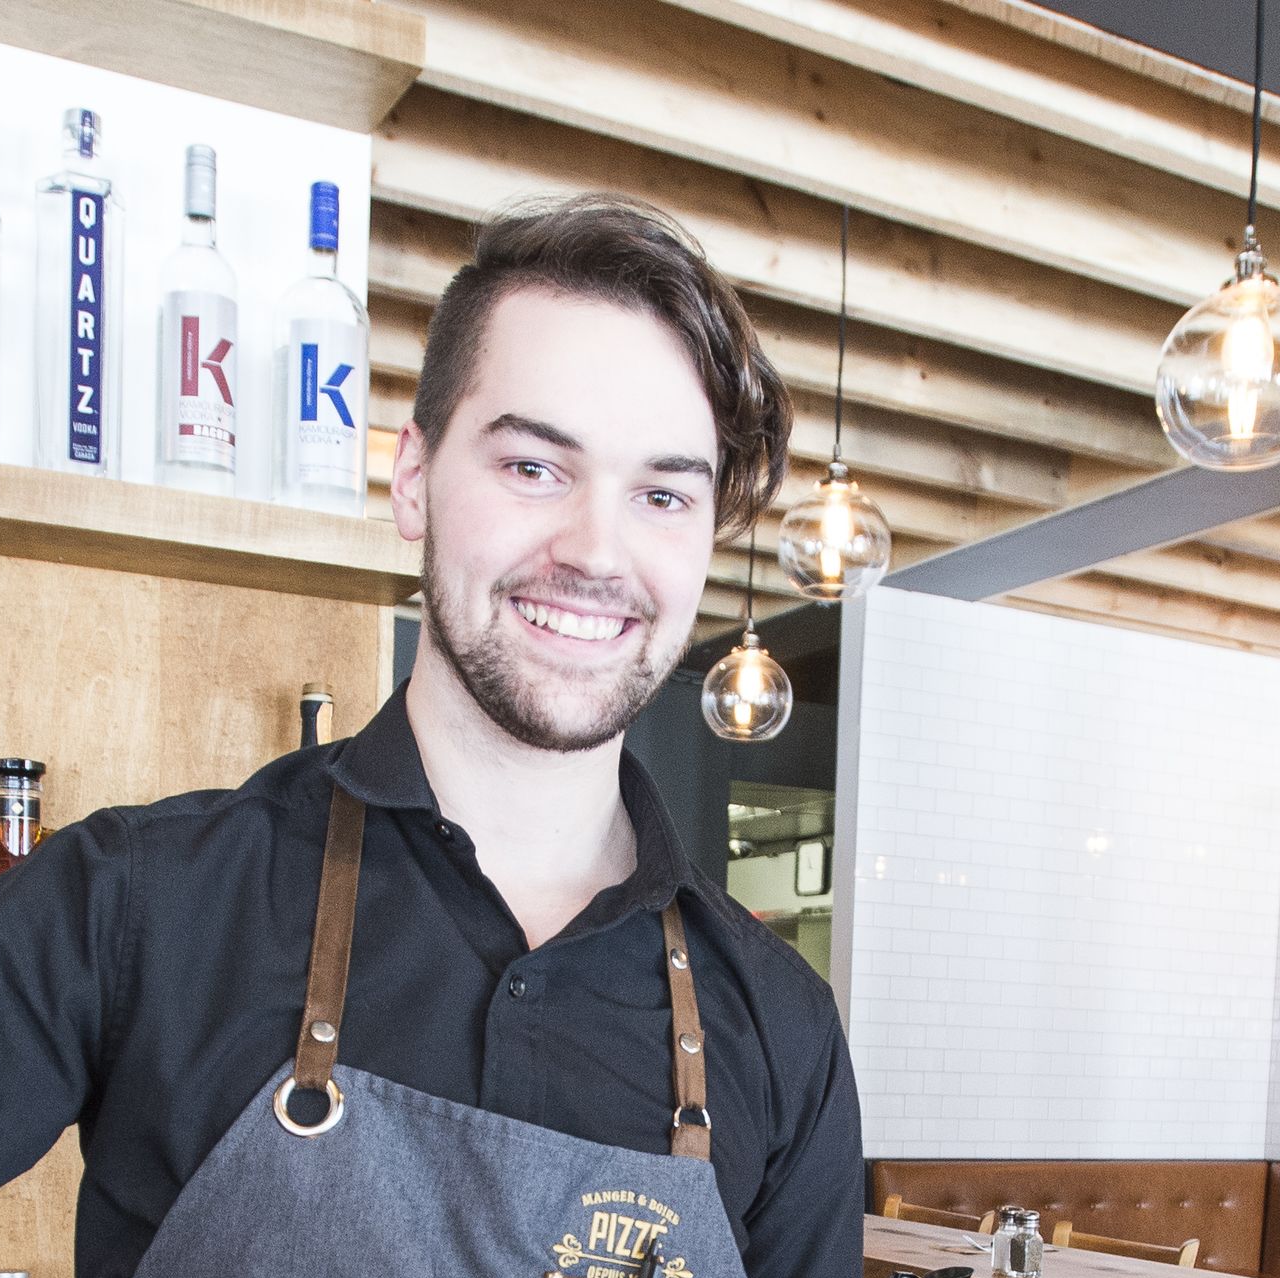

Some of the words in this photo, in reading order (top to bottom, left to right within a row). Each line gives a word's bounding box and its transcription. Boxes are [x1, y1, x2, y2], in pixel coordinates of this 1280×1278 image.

[77, 196, 97, 415] QUARTZ
[72, 421, 98, 436] VODKA
[581, 1189, 636, 1207] MANGER
[637, 1194, 648, 1206] &
[648, 1197, 681, 1226] BOIRE
